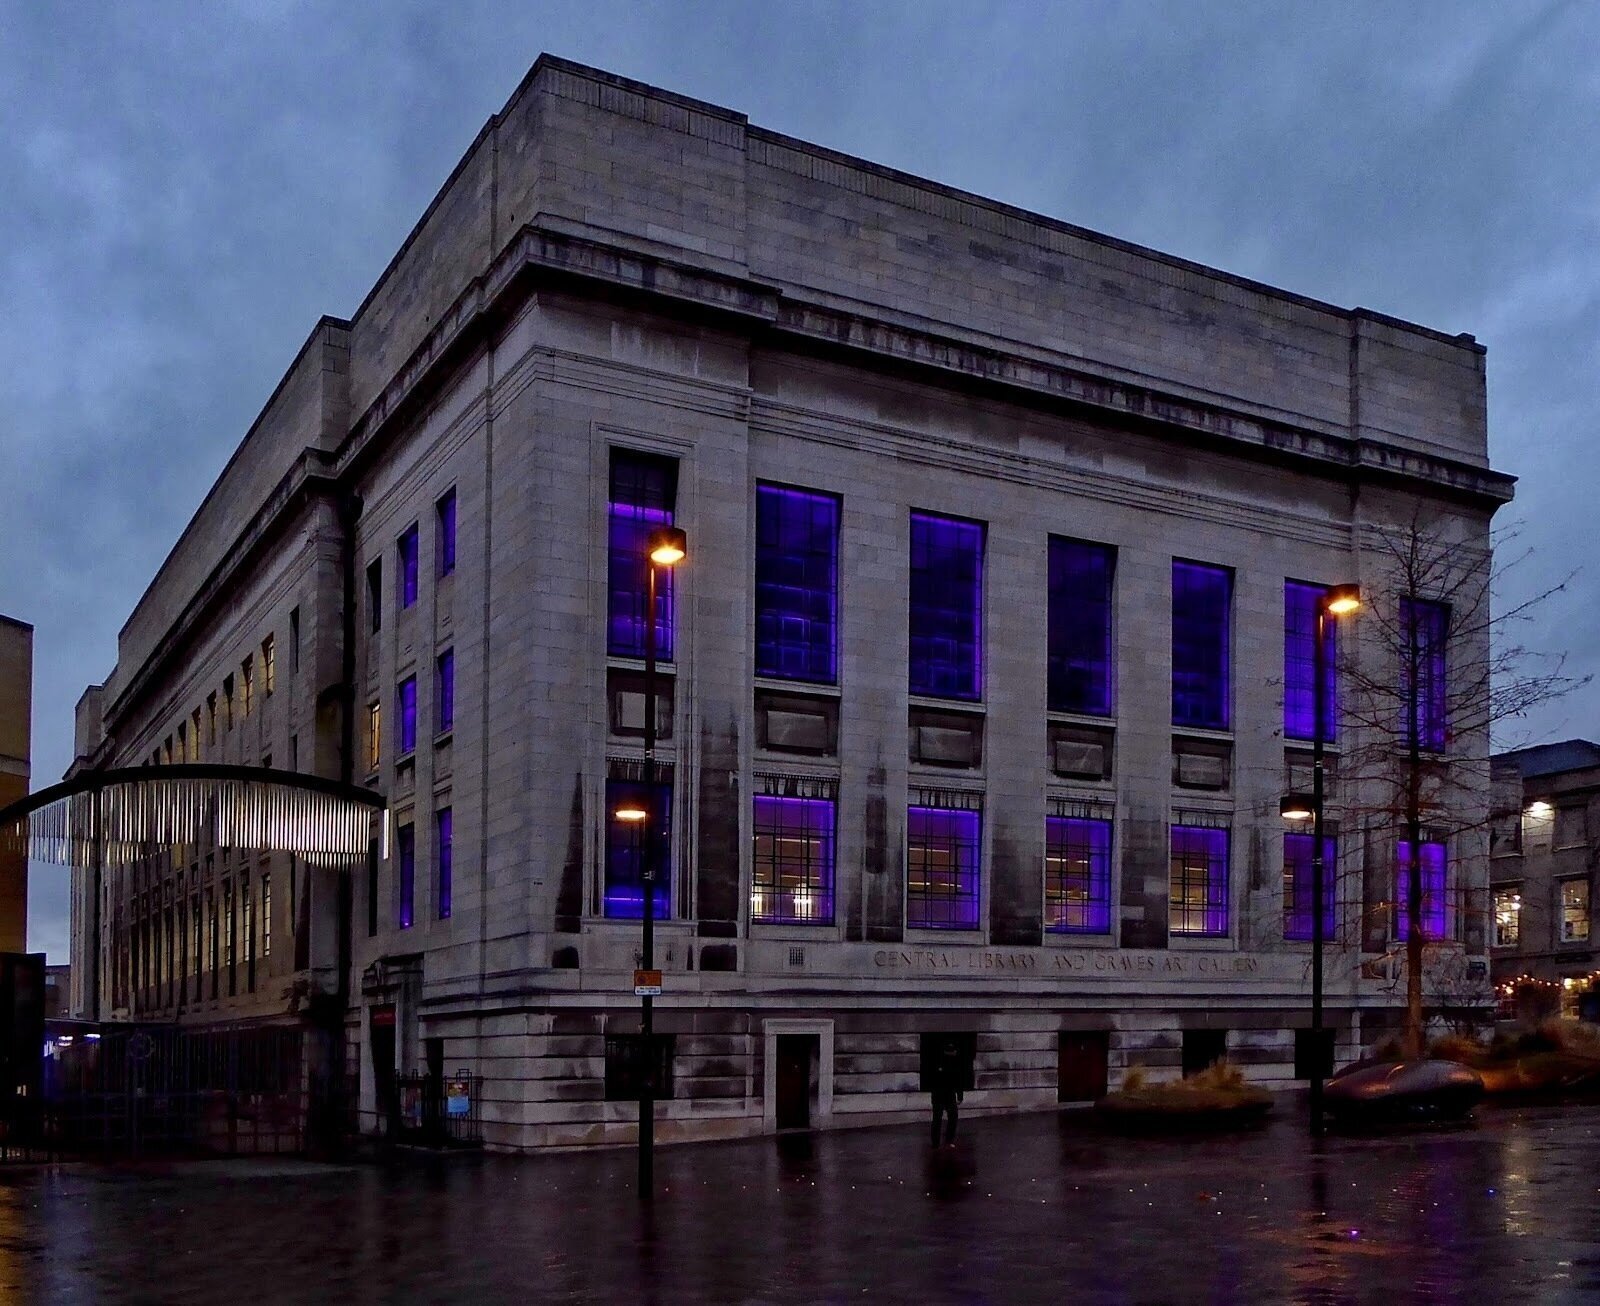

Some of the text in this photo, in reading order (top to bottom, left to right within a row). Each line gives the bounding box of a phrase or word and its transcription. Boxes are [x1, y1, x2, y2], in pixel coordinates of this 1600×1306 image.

[874, 950, 959, 968] CENTRAL
[969, 952, 1035, 969] LIBRARY
[1054, 954, 1085, 970] AND
[1095, 955, 1154, 971] GRAVES
[1162, 956, 1189, 972] ART
